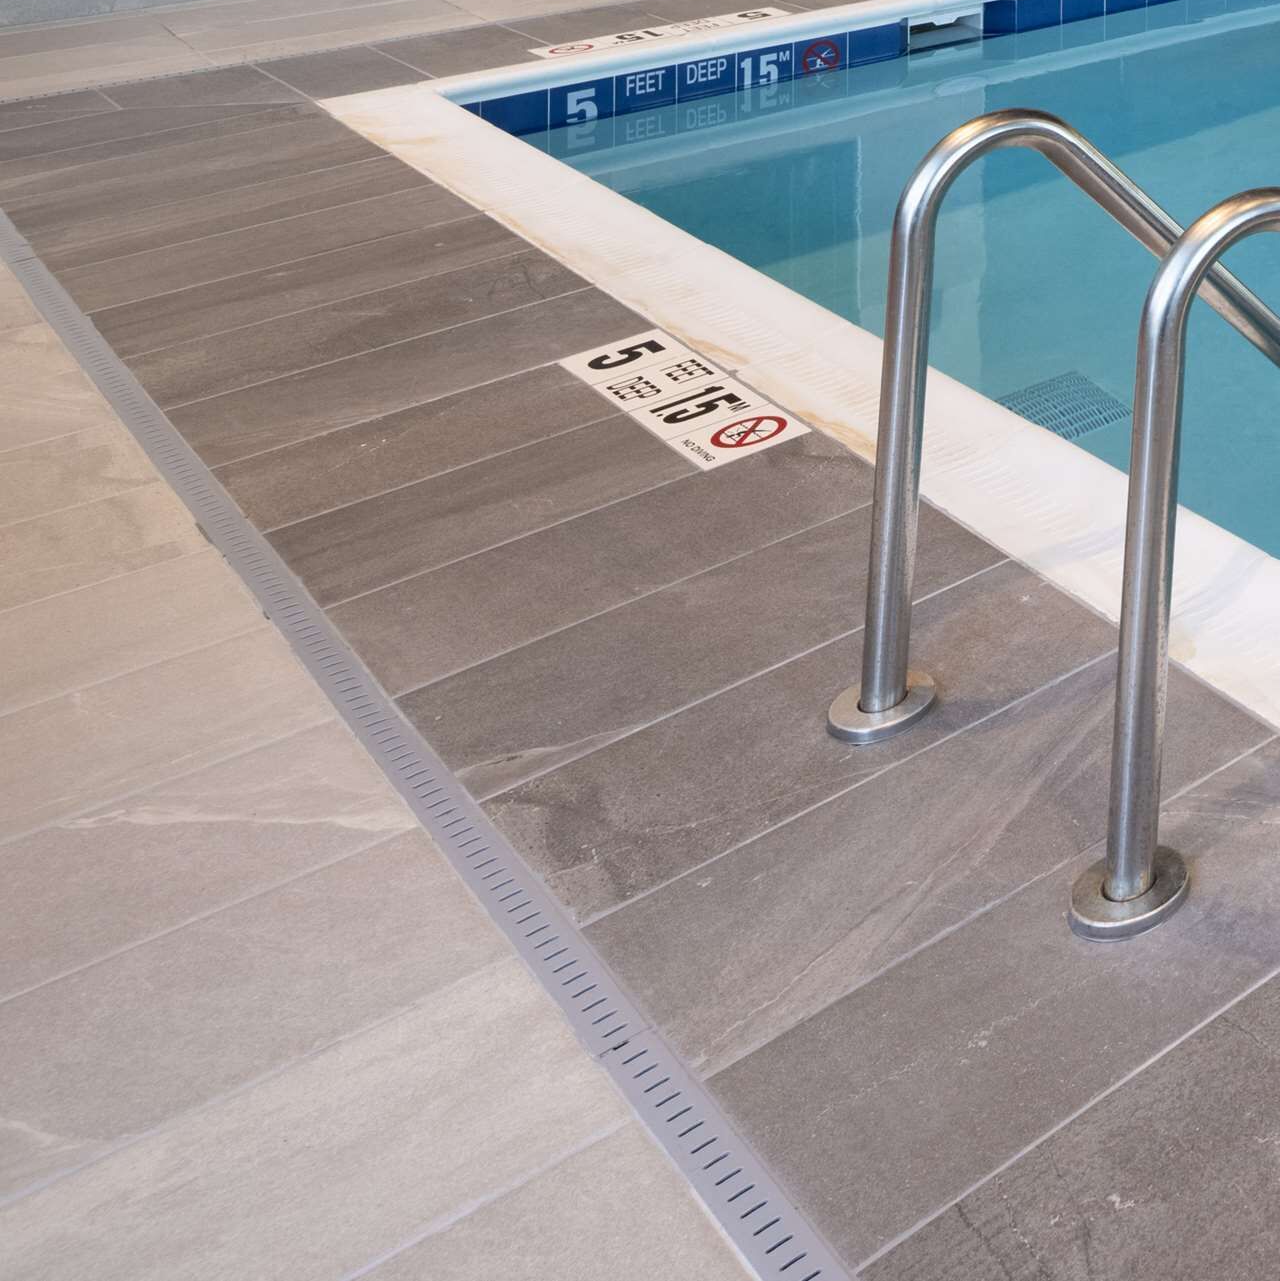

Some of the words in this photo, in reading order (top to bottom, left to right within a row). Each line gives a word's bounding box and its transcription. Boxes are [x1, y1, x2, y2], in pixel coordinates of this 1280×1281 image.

[565, 87, 599, 125] 5
[625, 70, 666, 97] FEET
[686, 58, 728, 85] DEEP
[587, 339, 667, 370] 5
[659, 358, 715, 384] FEET
[606, 375, 662, 402] DEEP
[680, 438, 694, 450] NO
[689, 445, 716, 462] DIVING
